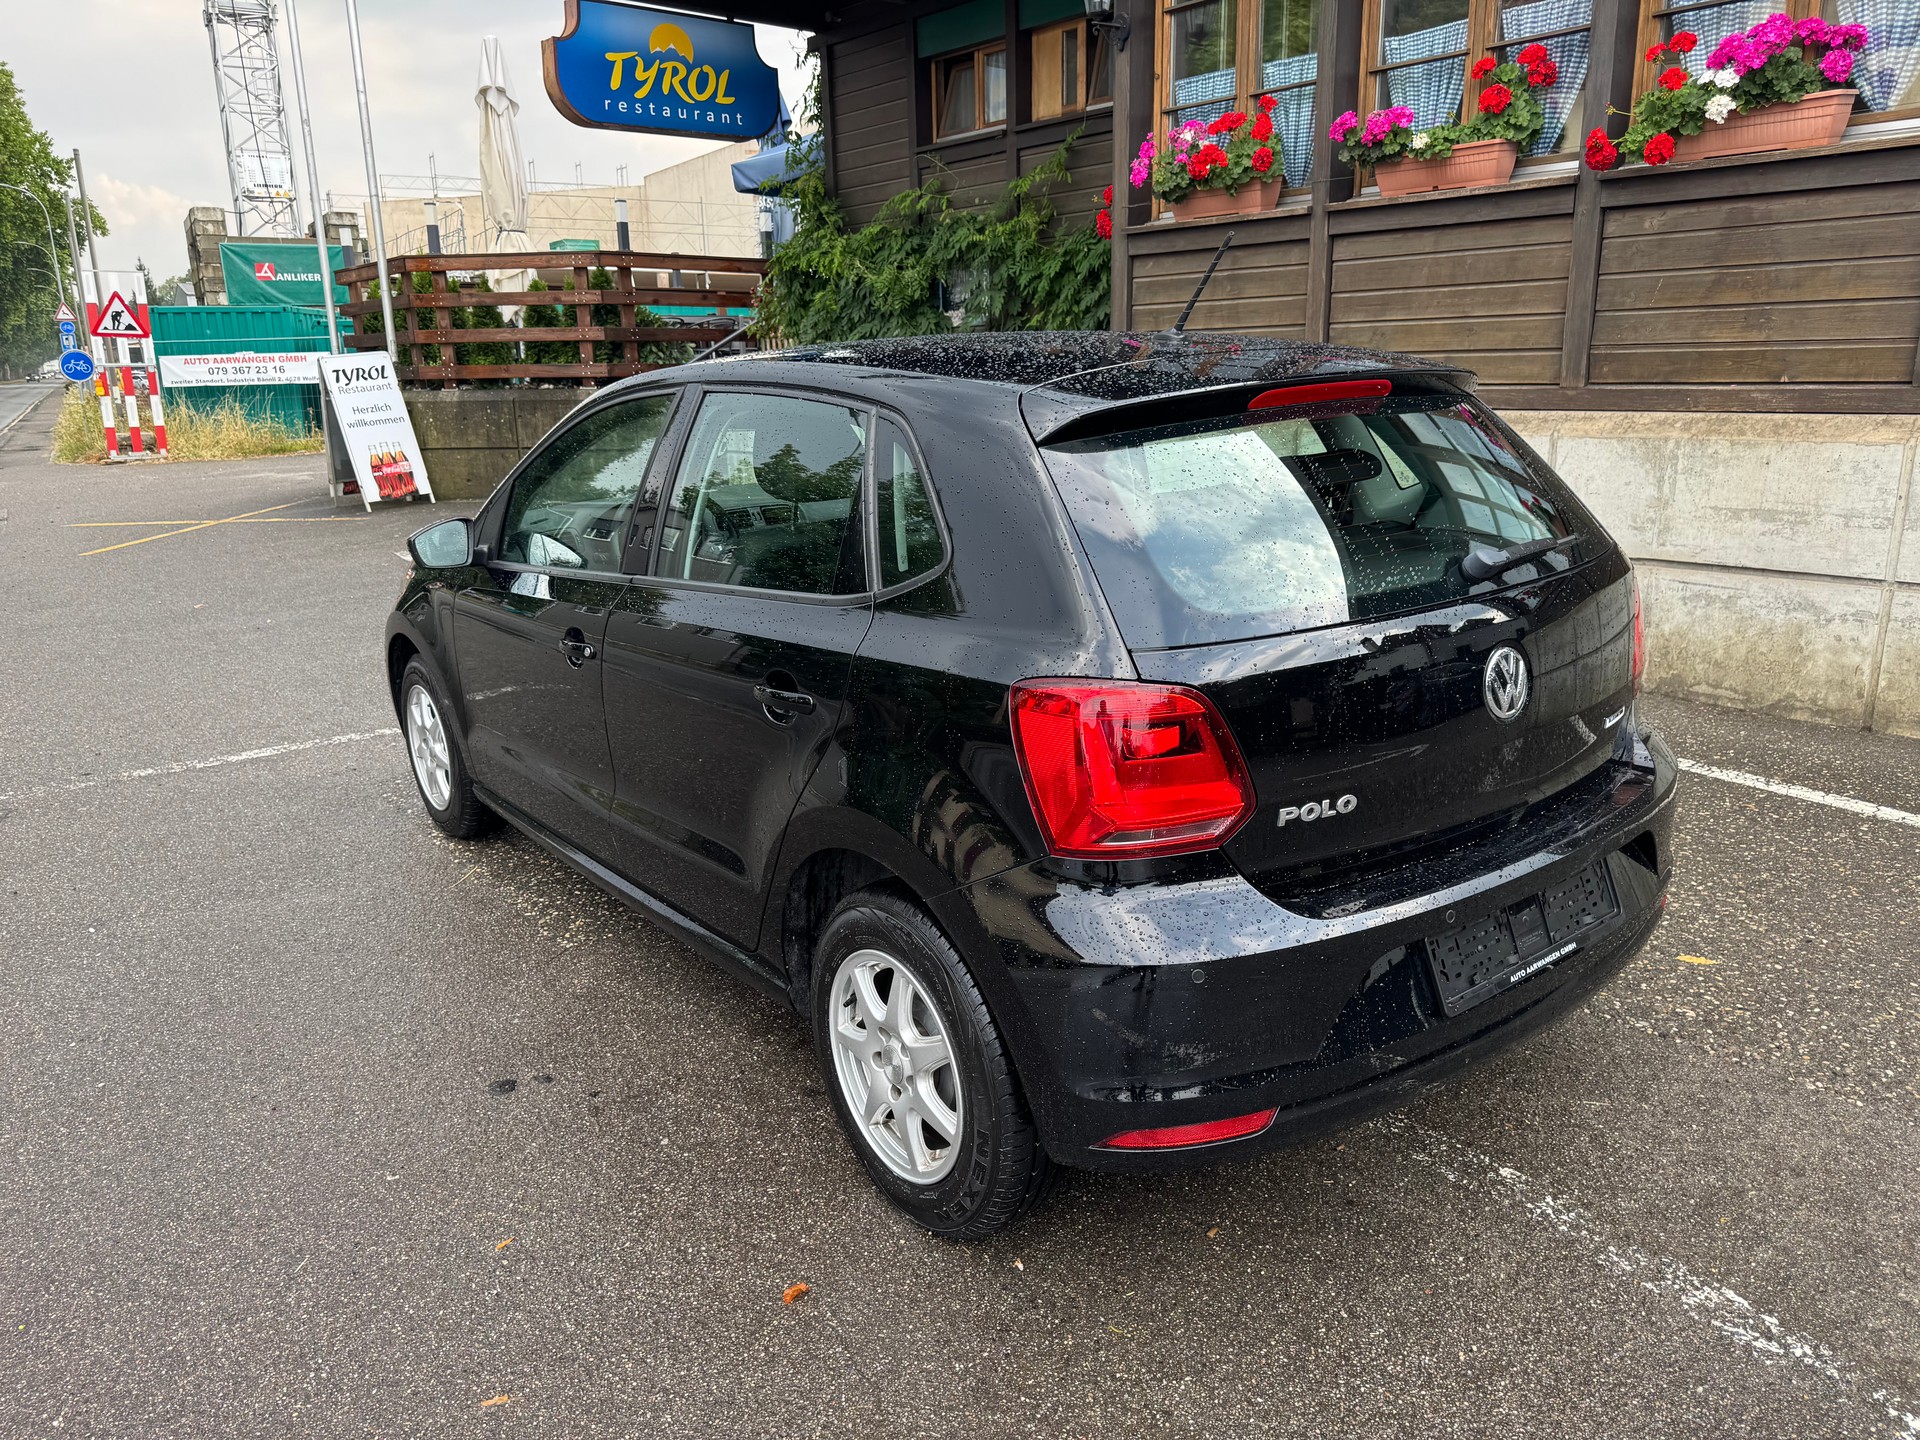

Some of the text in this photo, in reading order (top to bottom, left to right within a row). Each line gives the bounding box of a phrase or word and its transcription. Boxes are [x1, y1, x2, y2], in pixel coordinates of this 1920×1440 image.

[604, 51, 736, 105] TYROL
[605, 99, 743, 126] restaurant
[276, 273, 322, 282] ANLIKER
[183, 354, 307, 366] AUTO AARWANGEN GMBH
[207, 365, 286, 376] 079 367 23 16
[332, 364, 389, 387] TYROL
[337, 381, 393, 395] Restaurant
[351, 402, 392, 415] Herzlich
[346, 415, 406, 430] willkommen
[1276, 794, 1358, 827] POLO
[1510, 941, 1577, 983] AUTO AARWANGEN GMBH
